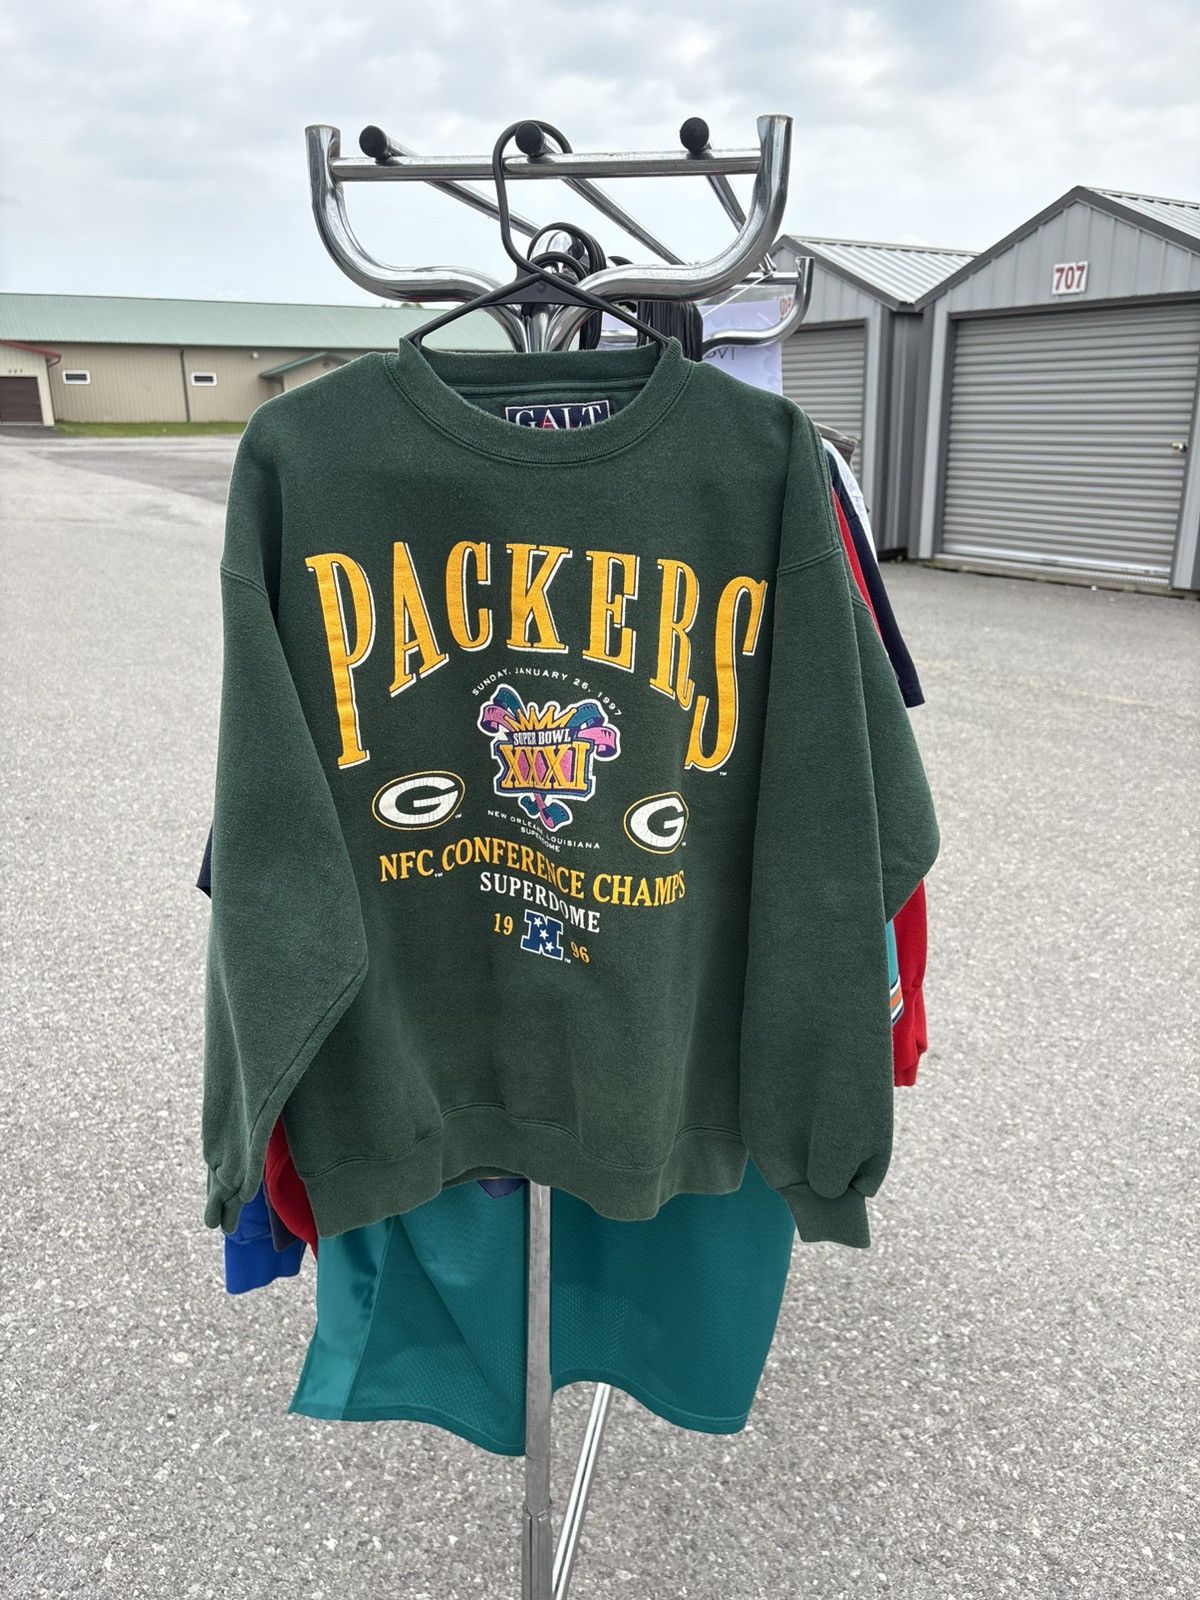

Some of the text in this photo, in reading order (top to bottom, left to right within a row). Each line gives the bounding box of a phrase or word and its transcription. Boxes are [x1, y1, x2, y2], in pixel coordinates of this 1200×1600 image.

[1055, 265, 1086, 291] 707
[515, 405, 602, 430] GALT
[304, 541, 768, 770] PACKERS
[472, 667, 623, 717] SUNDAY, JANUARY 26, 1997
[513, 728, 571, 746] SUPER BOWL
[499, 743, 590, 790] XXXI
[487, 810, 508, 819] NEW
[545, 834, 600, 849] LOUISIANA
[379, 849, 435, 882] NFC
[441, 836, 585, 899] CONFERENCE
[593, 869, 686, 907] CHAMPS
[480, 872, 601, 934] SUPERDOME
[493, 913, 514, 936] 19
[571, 941, 590, 963] 96
